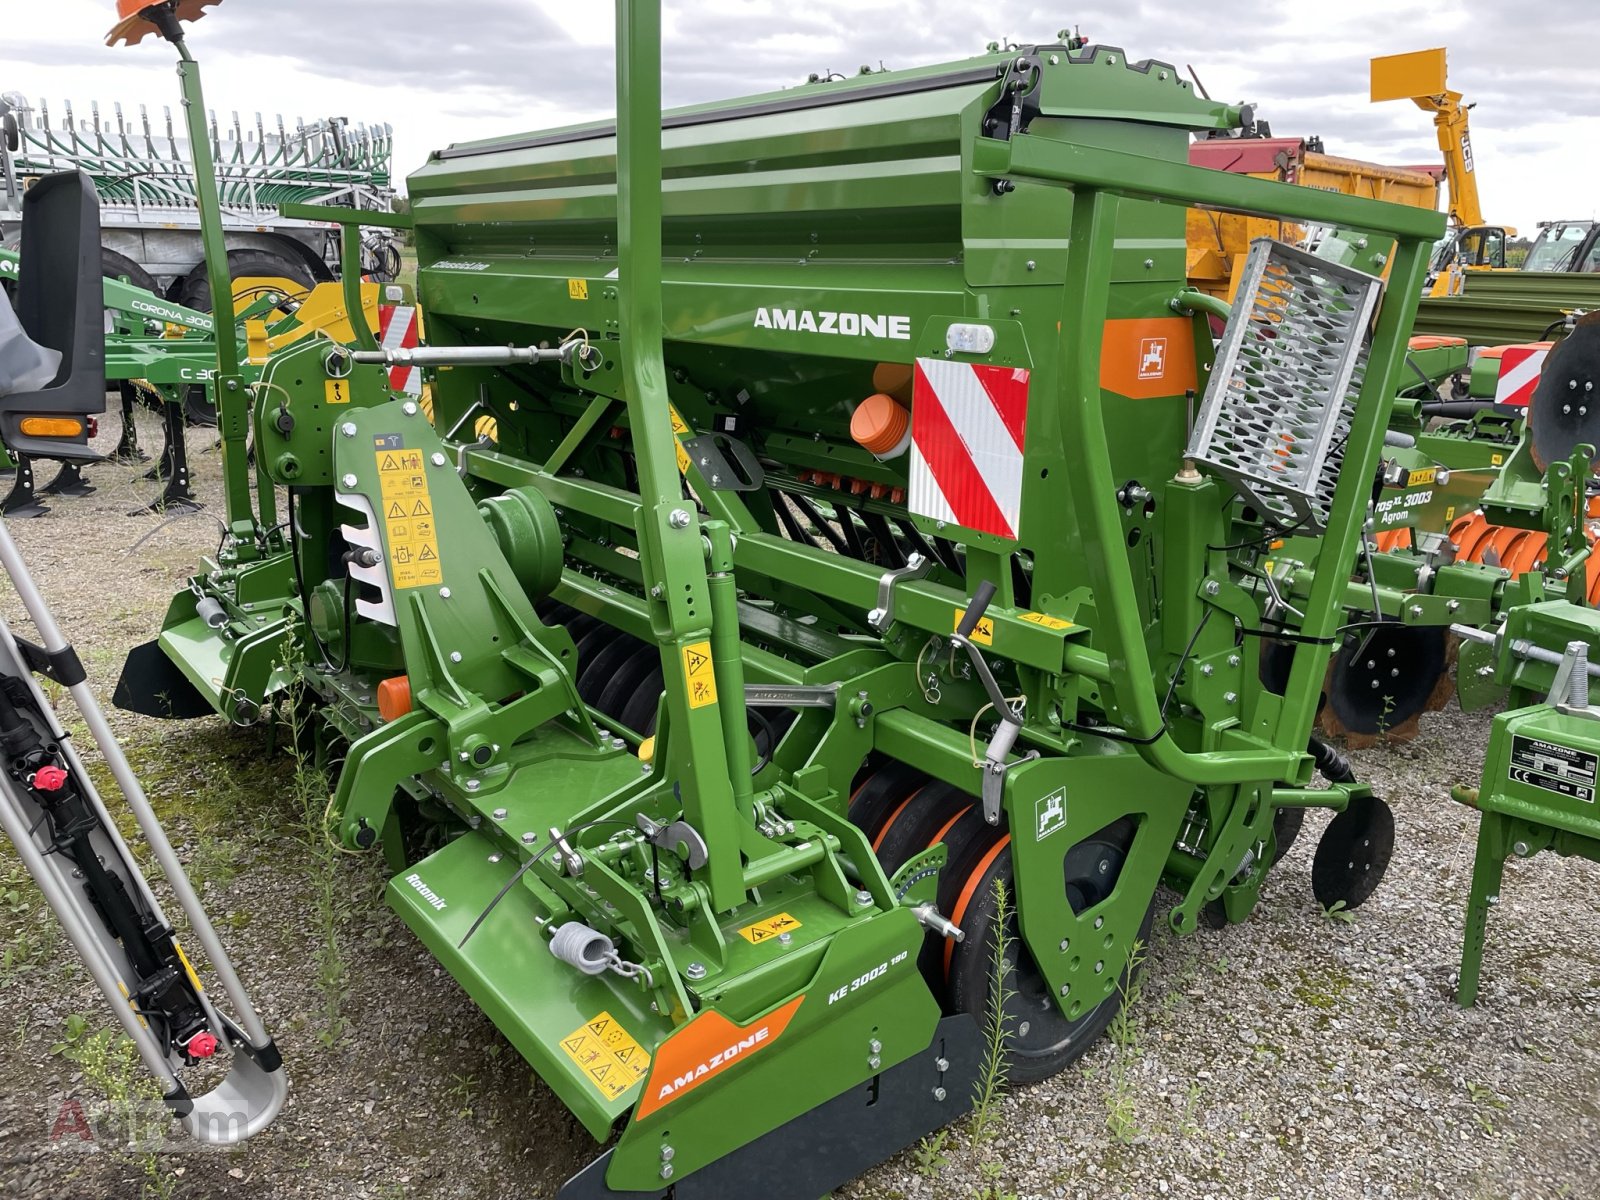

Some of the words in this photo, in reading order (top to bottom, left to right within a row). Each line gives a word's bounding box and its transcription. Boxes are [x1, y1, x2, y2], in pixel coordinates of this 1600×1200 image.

[1460, 135, 1474, 174] JCB
[131, 299, 183, 322] CORONA
[186, 314, 213, 329] 300
[753, 307, 911, 340] AMAZONE
[180, 368, 192, 380] C
[1403, 490, 1433, 508] 3003
[1380, 509, 1409, 525] Agrom
[1532, 741, 1577, 757] AMAZONE
[405, 873, 448, 911] Rotamix
[828, 984, 849, 1006] KE
[850, 962, 889, 993] 3002
[890, 950, 908, 966] 190
[658, 1026, 770, 1100] AMAZONE
